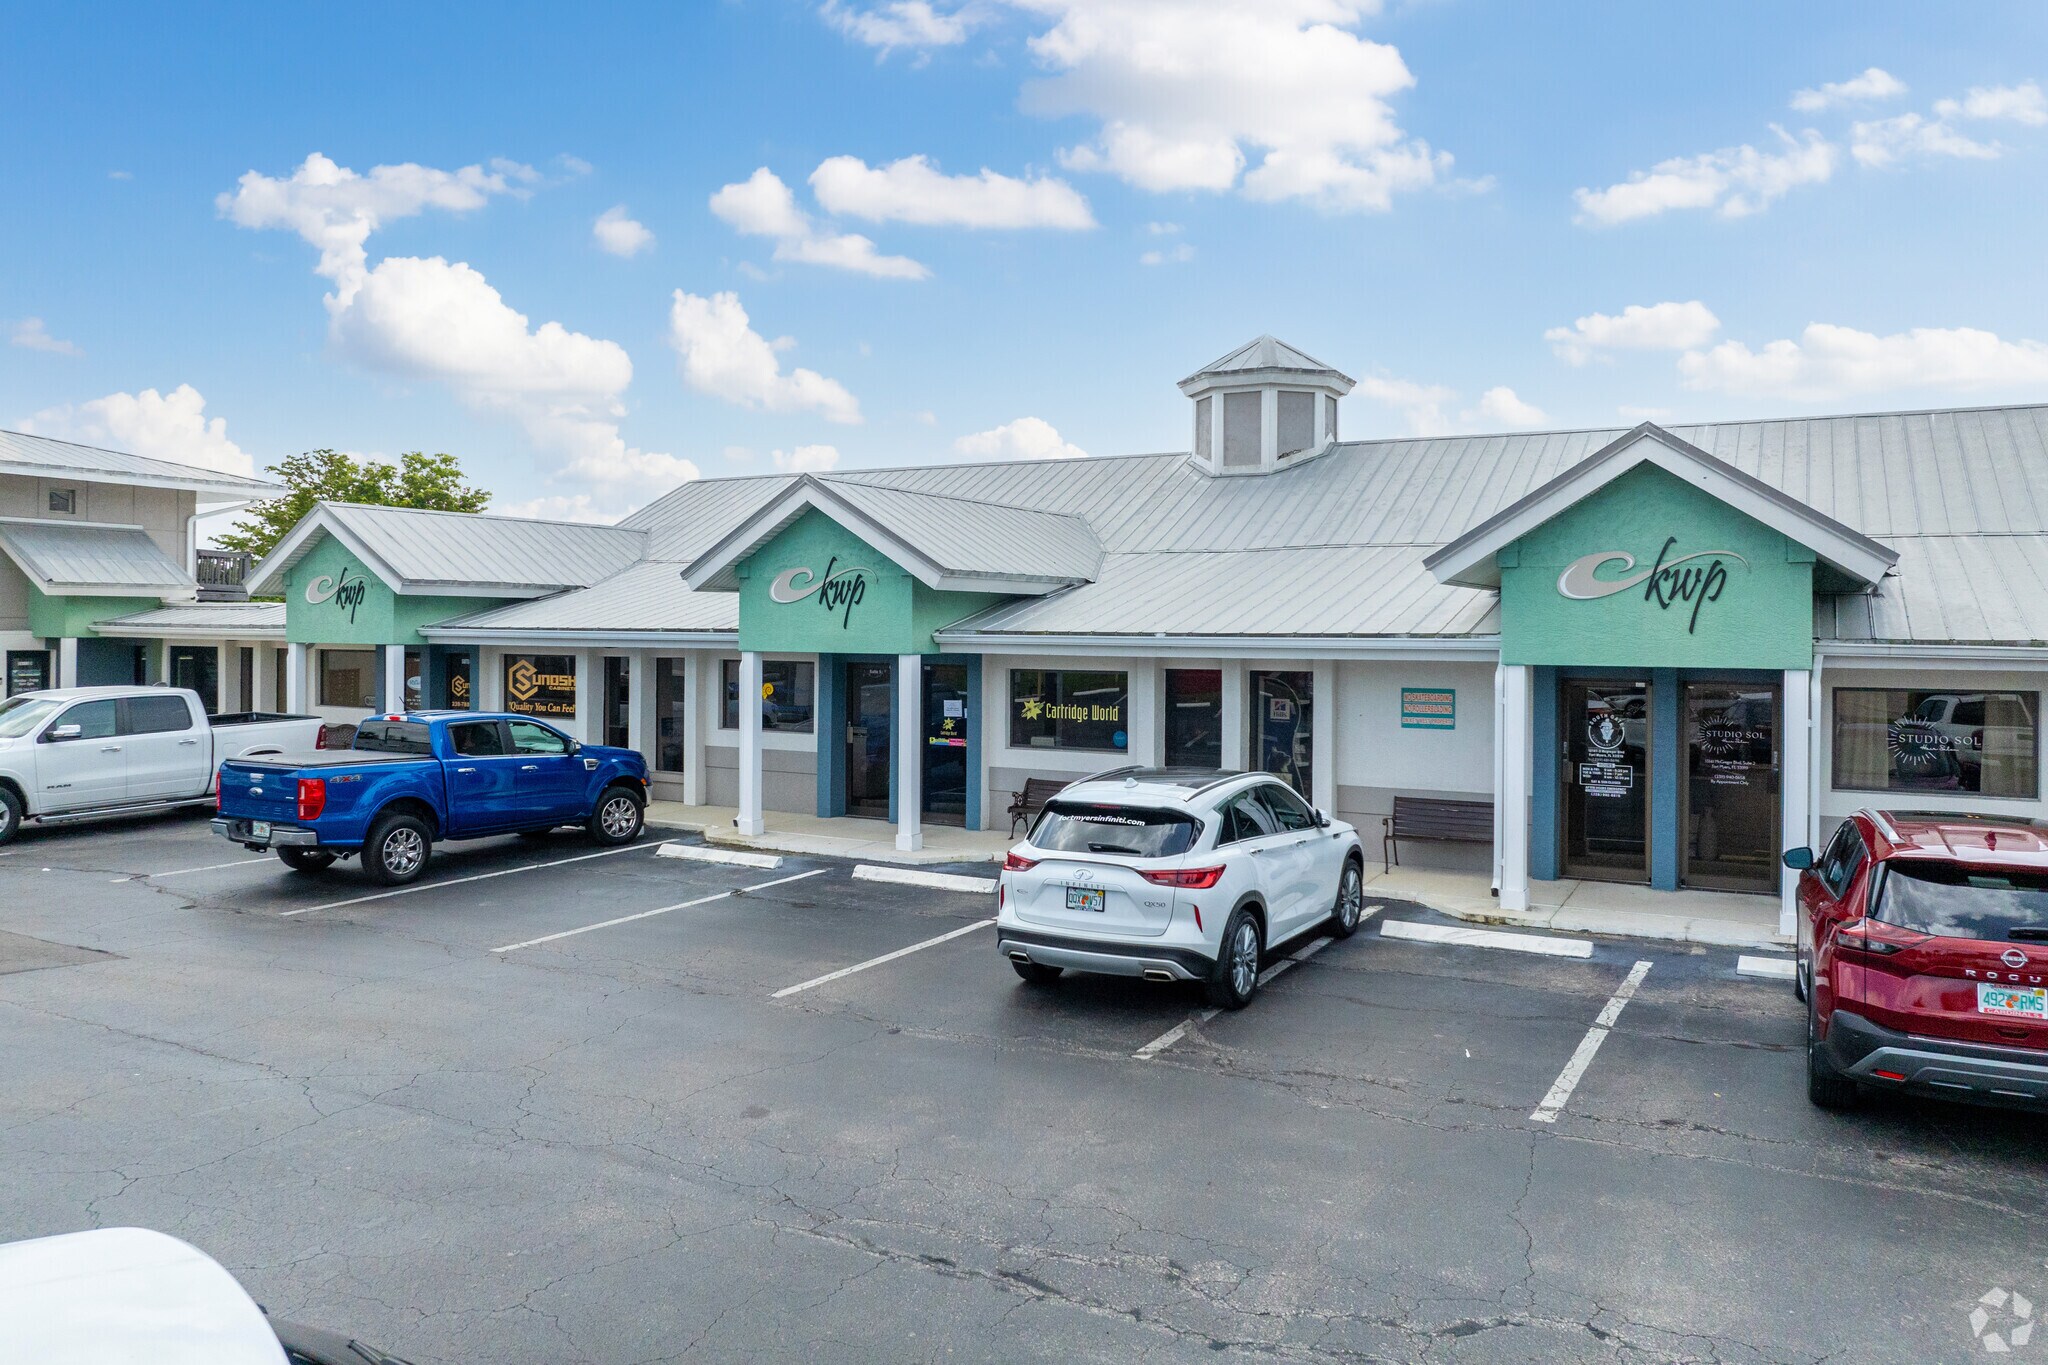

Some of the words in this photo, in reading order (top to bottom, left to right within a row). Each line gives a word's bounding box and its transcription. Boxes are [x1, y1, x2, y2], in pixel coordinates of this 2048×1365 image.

[1644, 536, 1727, 634] kwp
[818, 556, 866, 630] kwp
[535, 702, 546, 712] You
[547, 703, 560, 712] Can
[1046, 703, 1088, 723] Cartridge
[1091, 704, 1120, 721] World
[1706, 730, 1742, 738] STUDIO
[1745, 731, 1765, 739] SOL
[1898, 734, 1949, 744] STUDIO
[1954, 736, 1982, 745] SOL
[1060, 815, 1146, 826] fortmyersinfiniti.com
[1060, 881, 1106, 889] INFINITI
[1983, 992, 2006, 1007] 492
[2020, 994, 2044, 1011] RMS
[1987, 1008, 2041, 1018] CARDINALS
